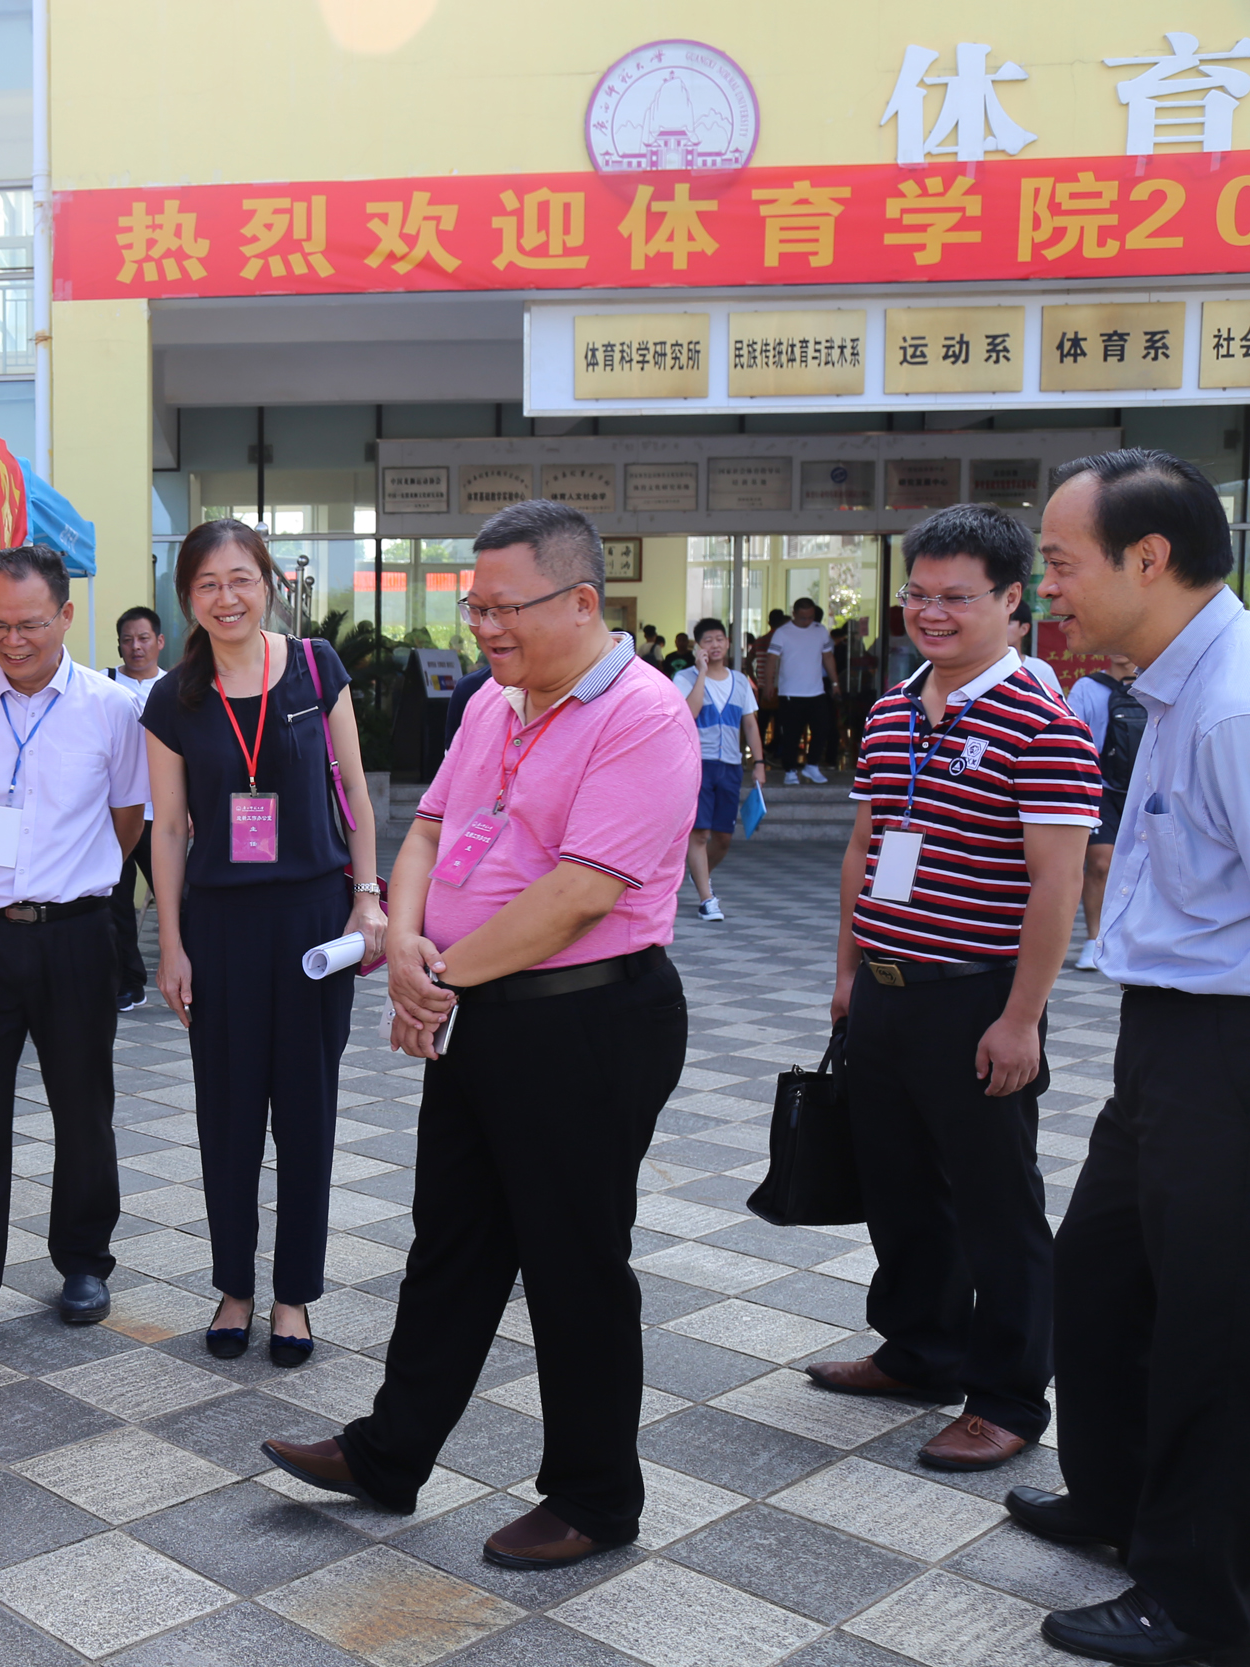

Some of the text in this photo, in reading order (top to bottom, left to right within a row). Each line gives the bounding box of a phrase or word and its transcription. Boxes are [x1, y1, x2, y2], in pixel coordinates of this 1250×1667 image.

[685, 51, 749, 138] GUANGXI NORMAL UNIVERSITY
[880, 32, 1250, 168] 体育
[584, 340, 701, 372] 体育科学研究所
[733, 337, 861, 370] 民族传统体育与武术系
[899, 333, 1011, 366] 运动系
[1056, 329, 1171, 364] 体育系
